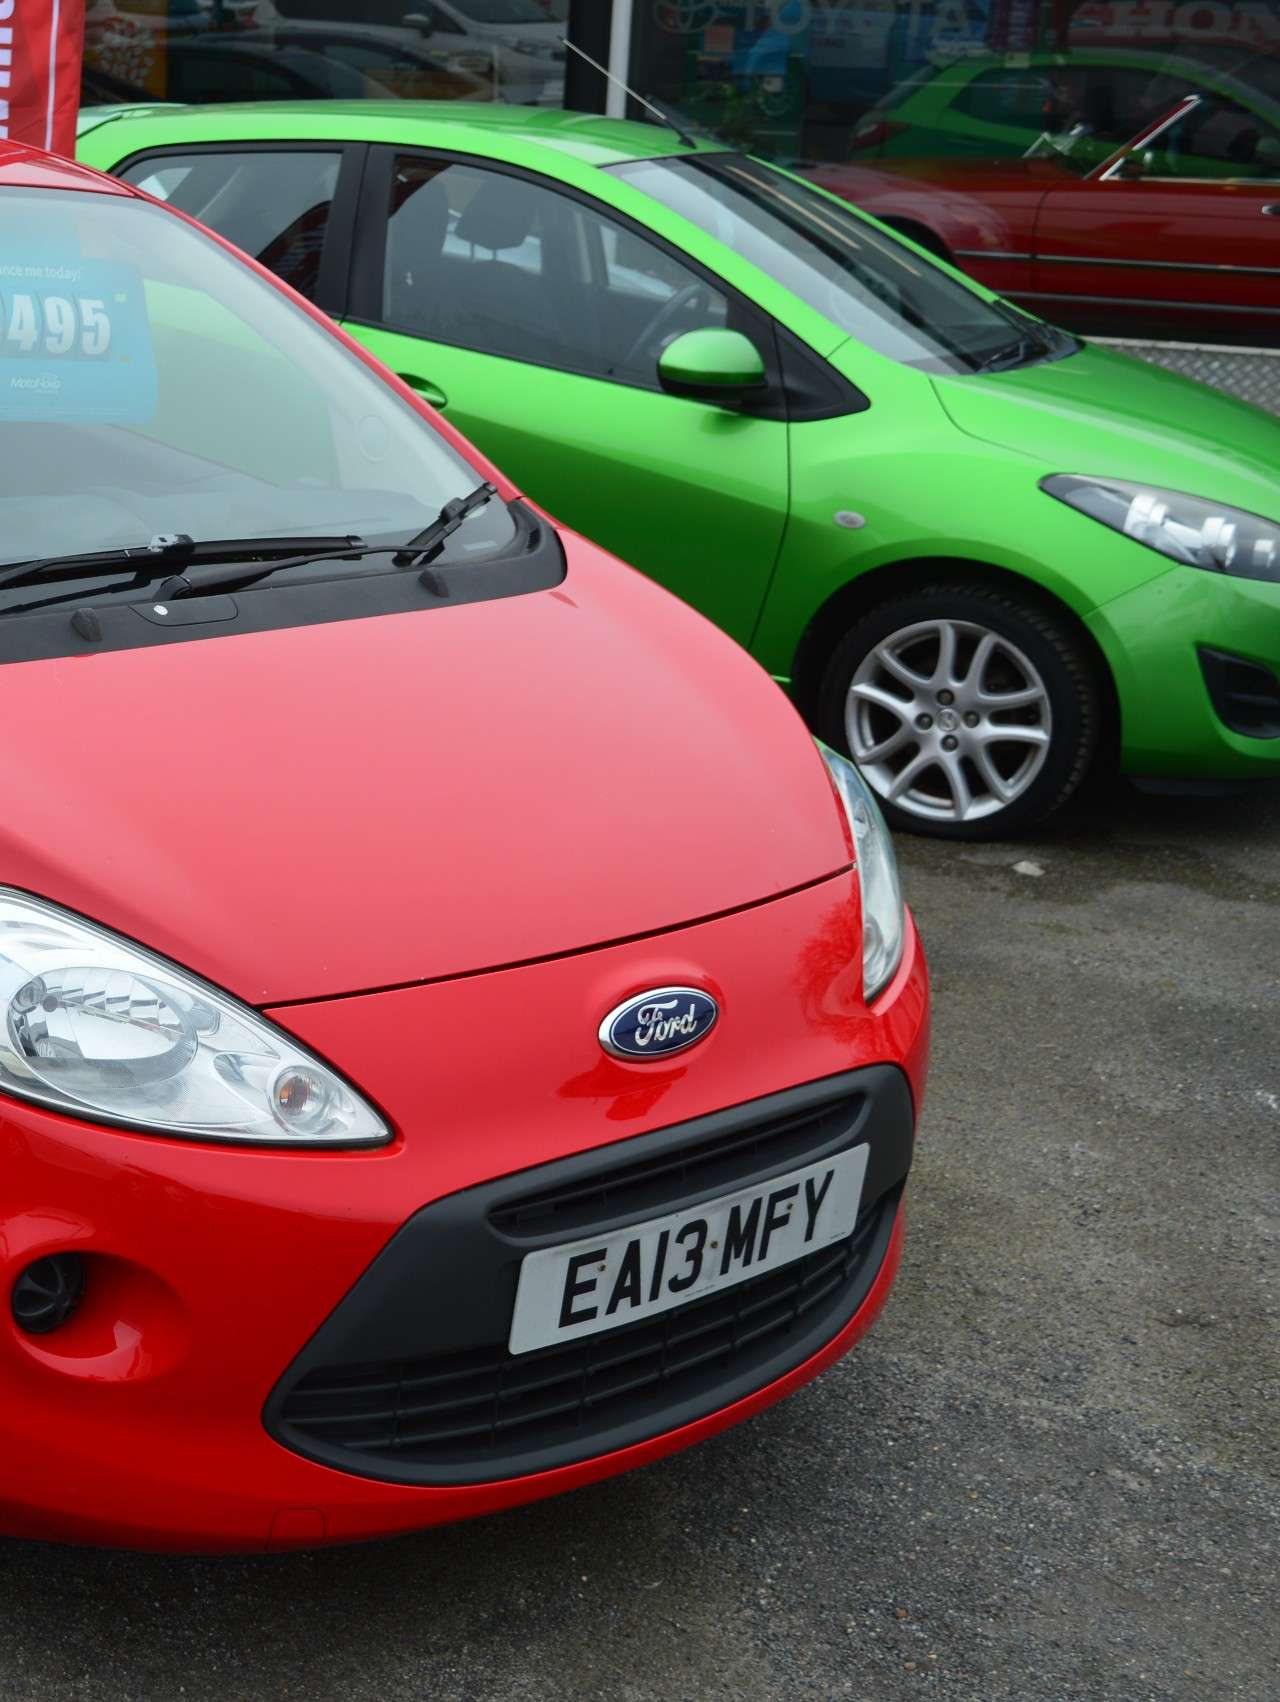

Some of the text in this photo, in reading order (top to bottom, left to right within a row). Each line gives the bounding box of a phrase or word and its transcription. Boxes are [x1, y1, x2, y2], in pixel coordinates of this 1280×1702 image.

[24, 265, 43, 278] me
[635, 1000, 697, 1046] Ford
[558, 1170, 836, 1328] EA13 MFY
